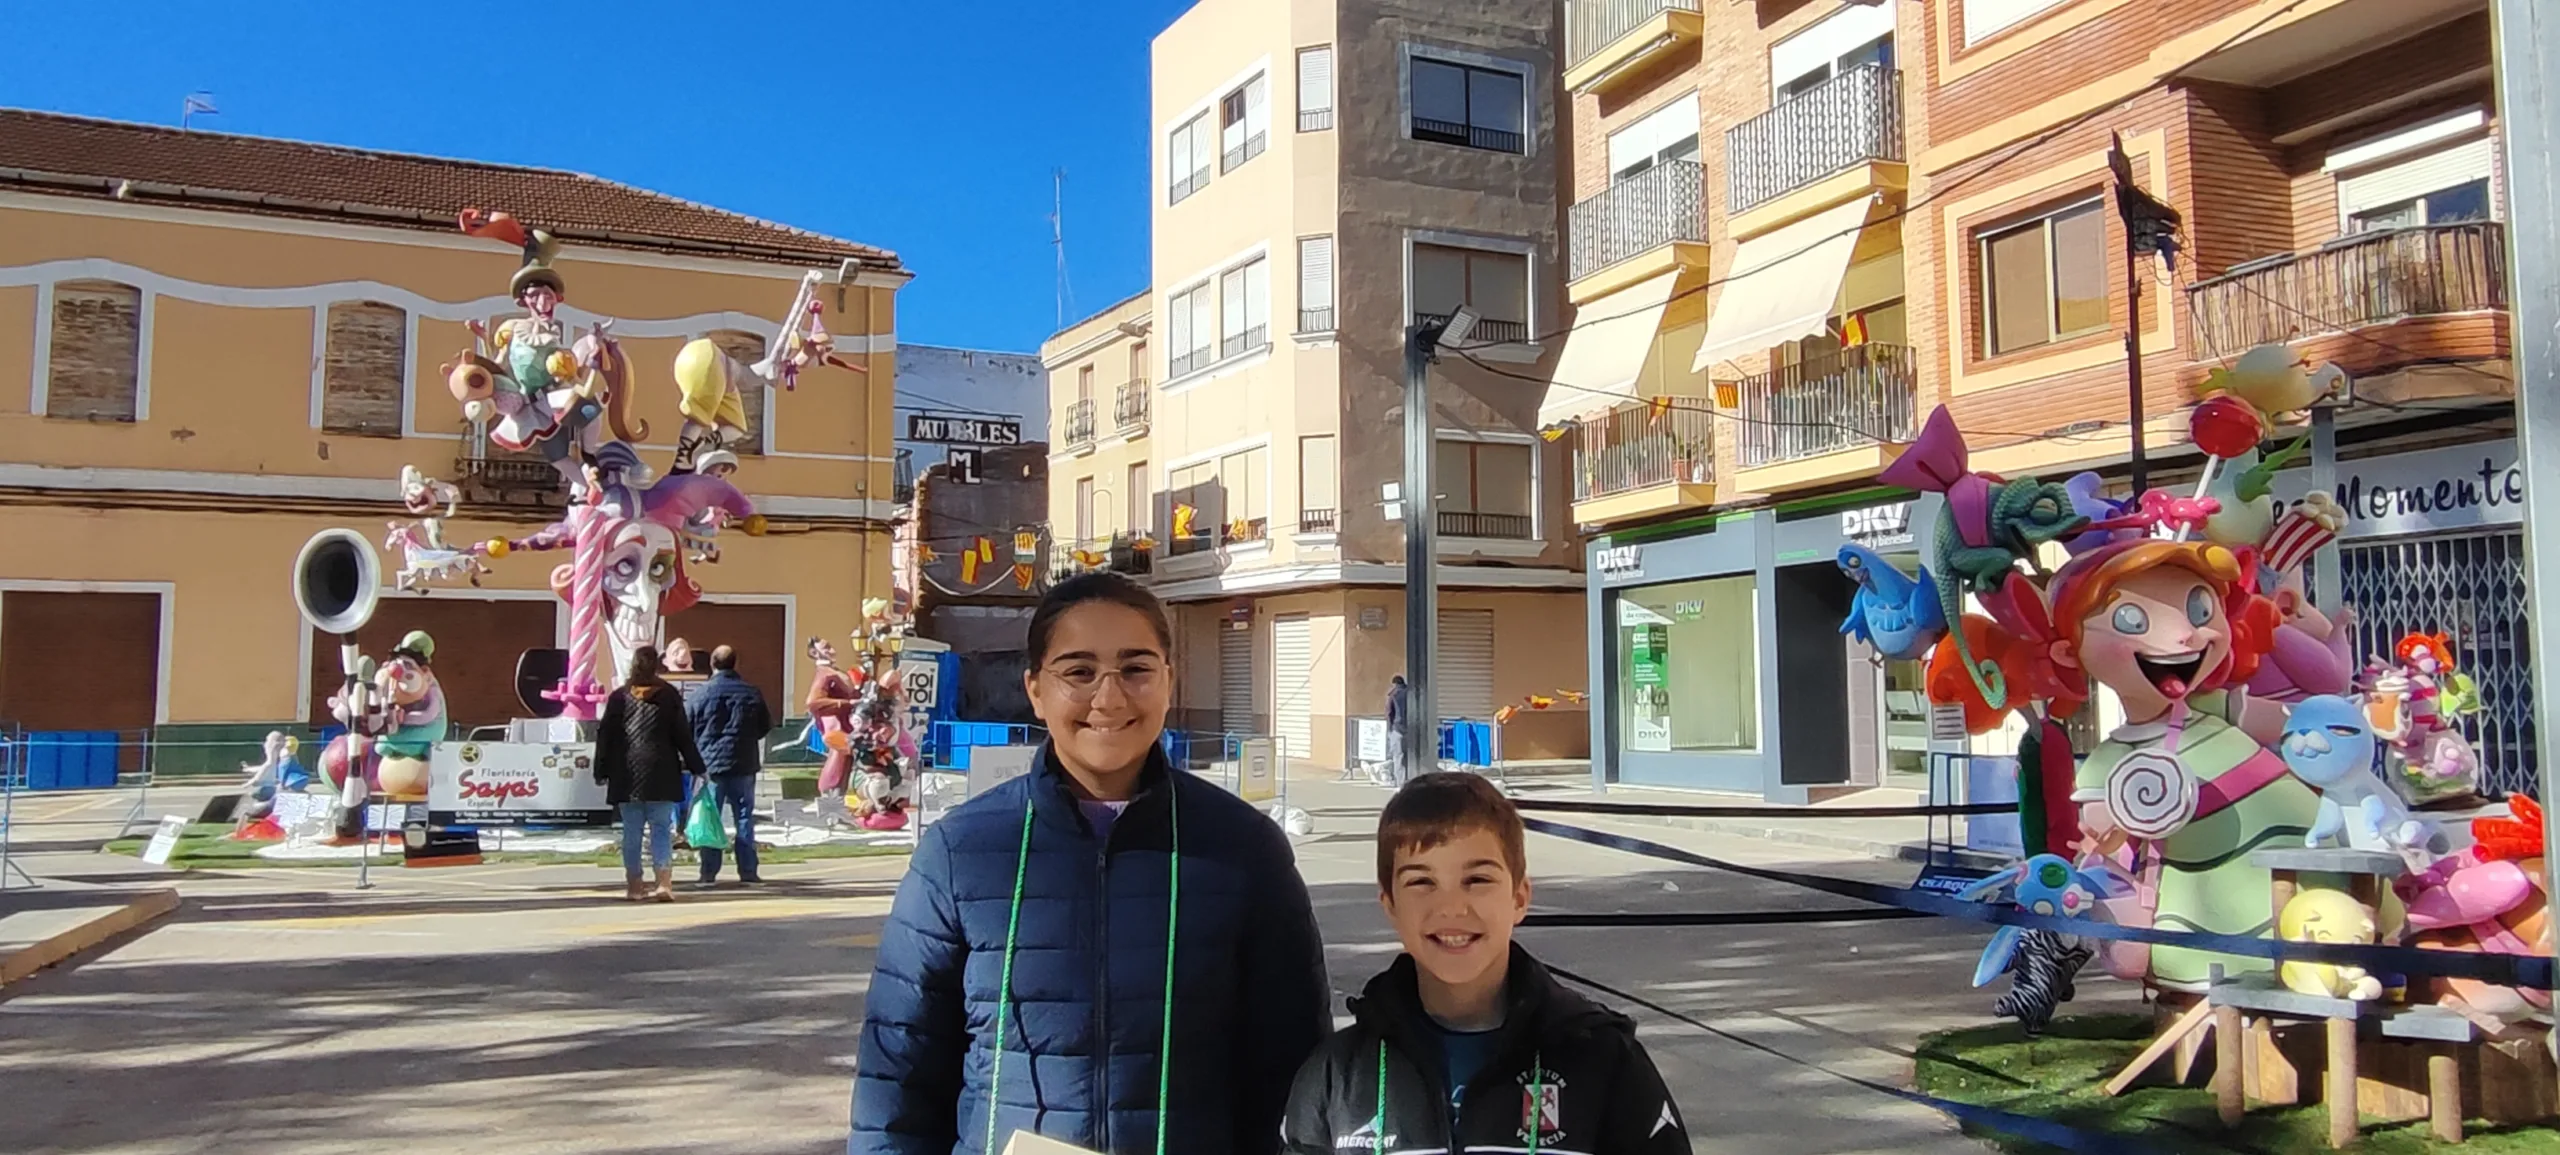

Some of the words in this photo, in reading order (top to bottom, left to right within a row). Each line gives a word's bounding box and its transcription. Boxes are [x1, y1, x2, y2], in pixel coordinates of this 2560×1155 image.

[1842, 502, 1906, 535] DKV
[1596, 545, 1637, 569] DKV
[1675, 600, 1703, 613] DKV
[1638, 731, 1667, 739] DKV
[458, 769, 539, 808] Sayas
[1516, 1067, 1567, 1088] STIUM
[1336, 1135, 1397, 1148] MERCRY
[1516, 1128, 1567, 1146] VEECIA
